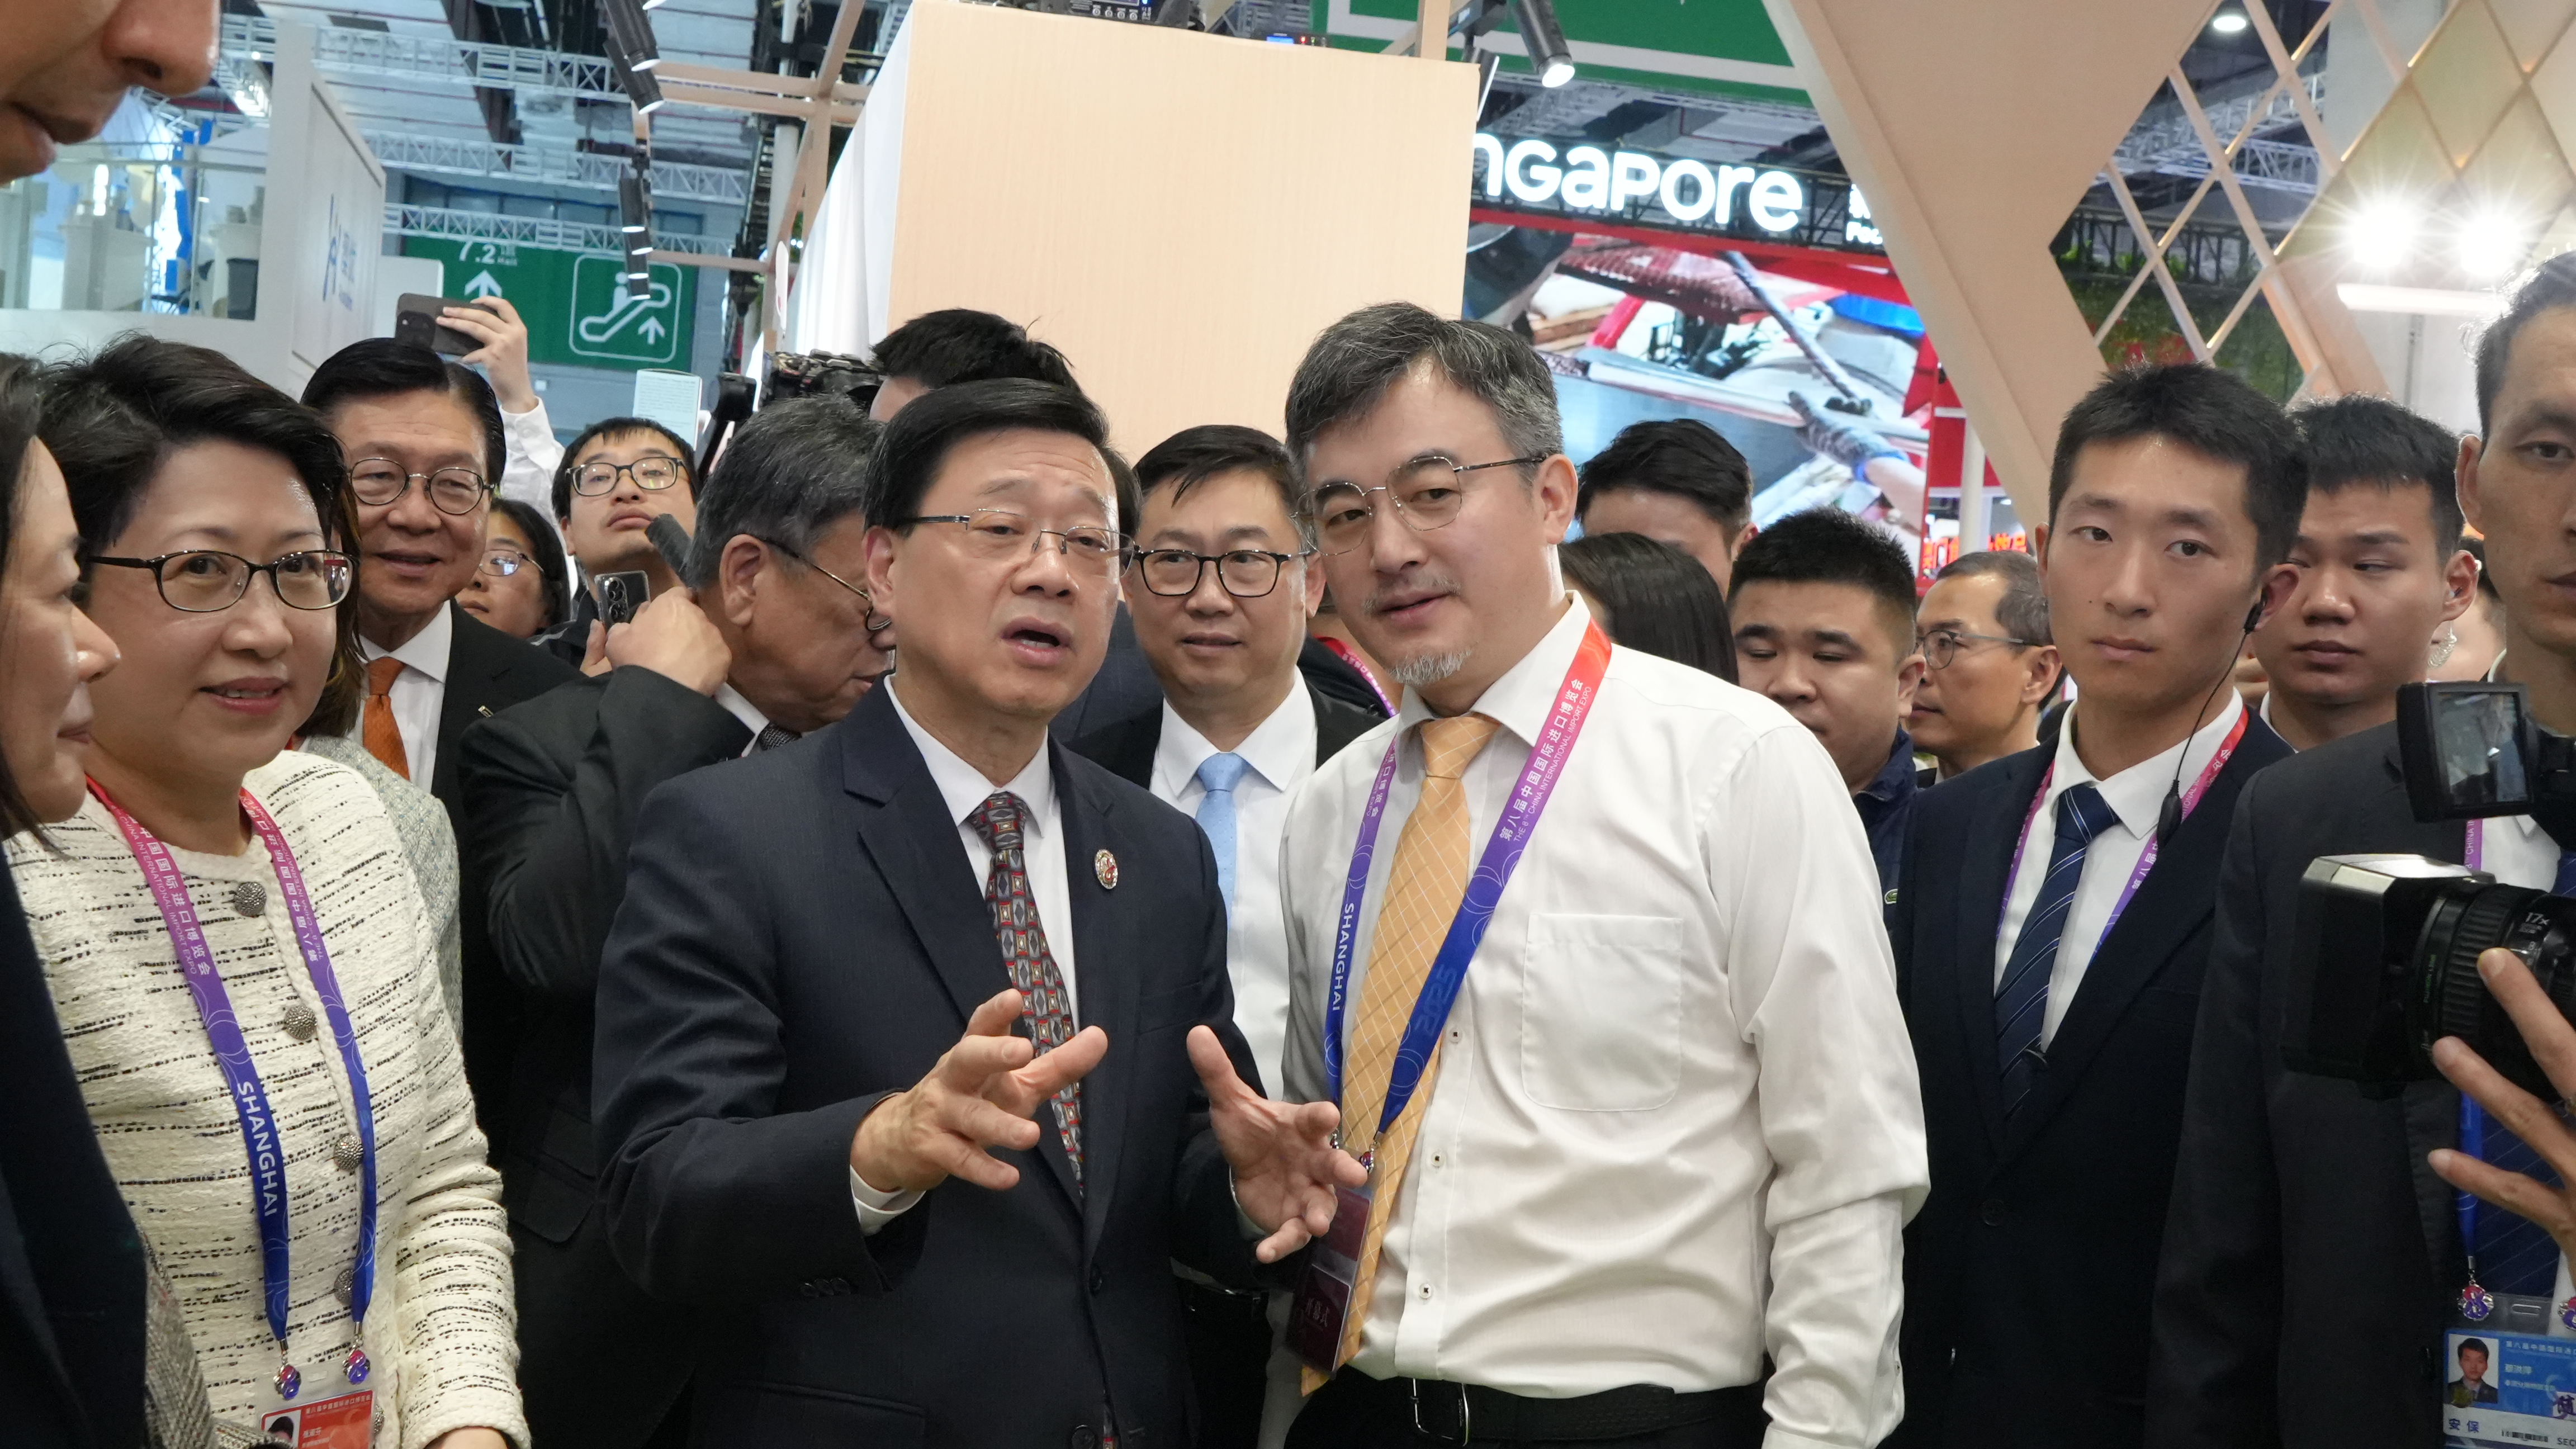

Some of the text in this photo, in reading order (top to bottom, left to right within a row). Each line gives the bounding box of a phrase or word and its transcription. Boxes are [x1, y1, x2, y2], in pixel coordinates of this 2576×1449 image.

[1499, 679, 1584, 841] 第八届中国国际进口博览会
[1513, 826, 1526, 842] THE
[1528, 791, 1543, 814] CHINA
[1540, 735, 1571, 791] INTERNATIONAL
[1568, 705, 1584, 734] IMPORT
[1579, 686, 1592, 706] EXPO
[119, 816, 197, 974] CHINA INTERNATIONAL IMPORT EXPO
[2466, 828, 2474, 855] CHINA
[301, 899, 313, 926] CHINA
[1332, 902, 1354, 1011] SHANGHAI
[238, 1081, 278, 1216] SHANGHAI
[2449, 1418, 2479, 1433] 安保
[2556, 1437, 2576, 1447] SEC
